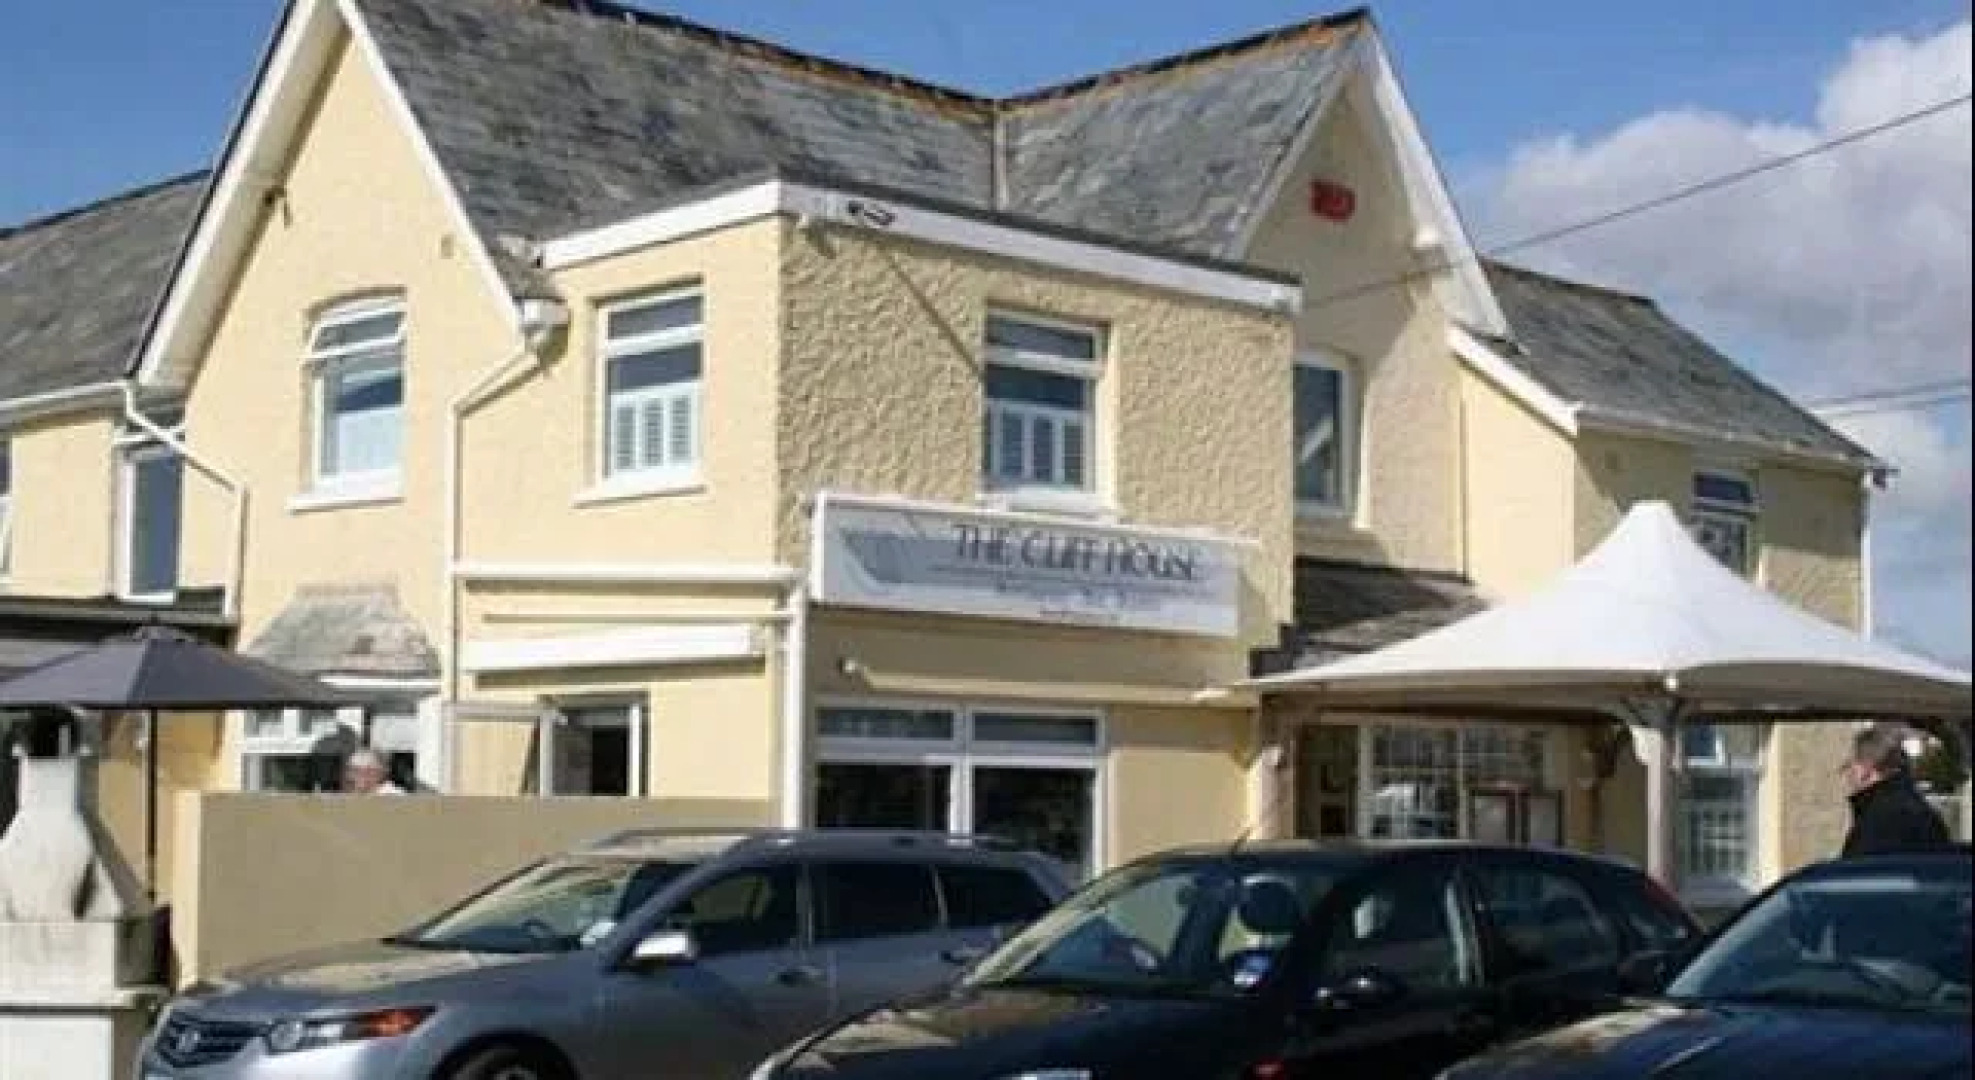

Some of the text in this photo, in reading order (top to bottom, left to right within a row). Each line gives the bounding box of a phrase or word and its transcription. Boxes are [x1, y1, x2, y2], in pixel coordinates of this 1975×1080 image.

[951, 522, 1205, 581] THE CLIFF HOUSE
